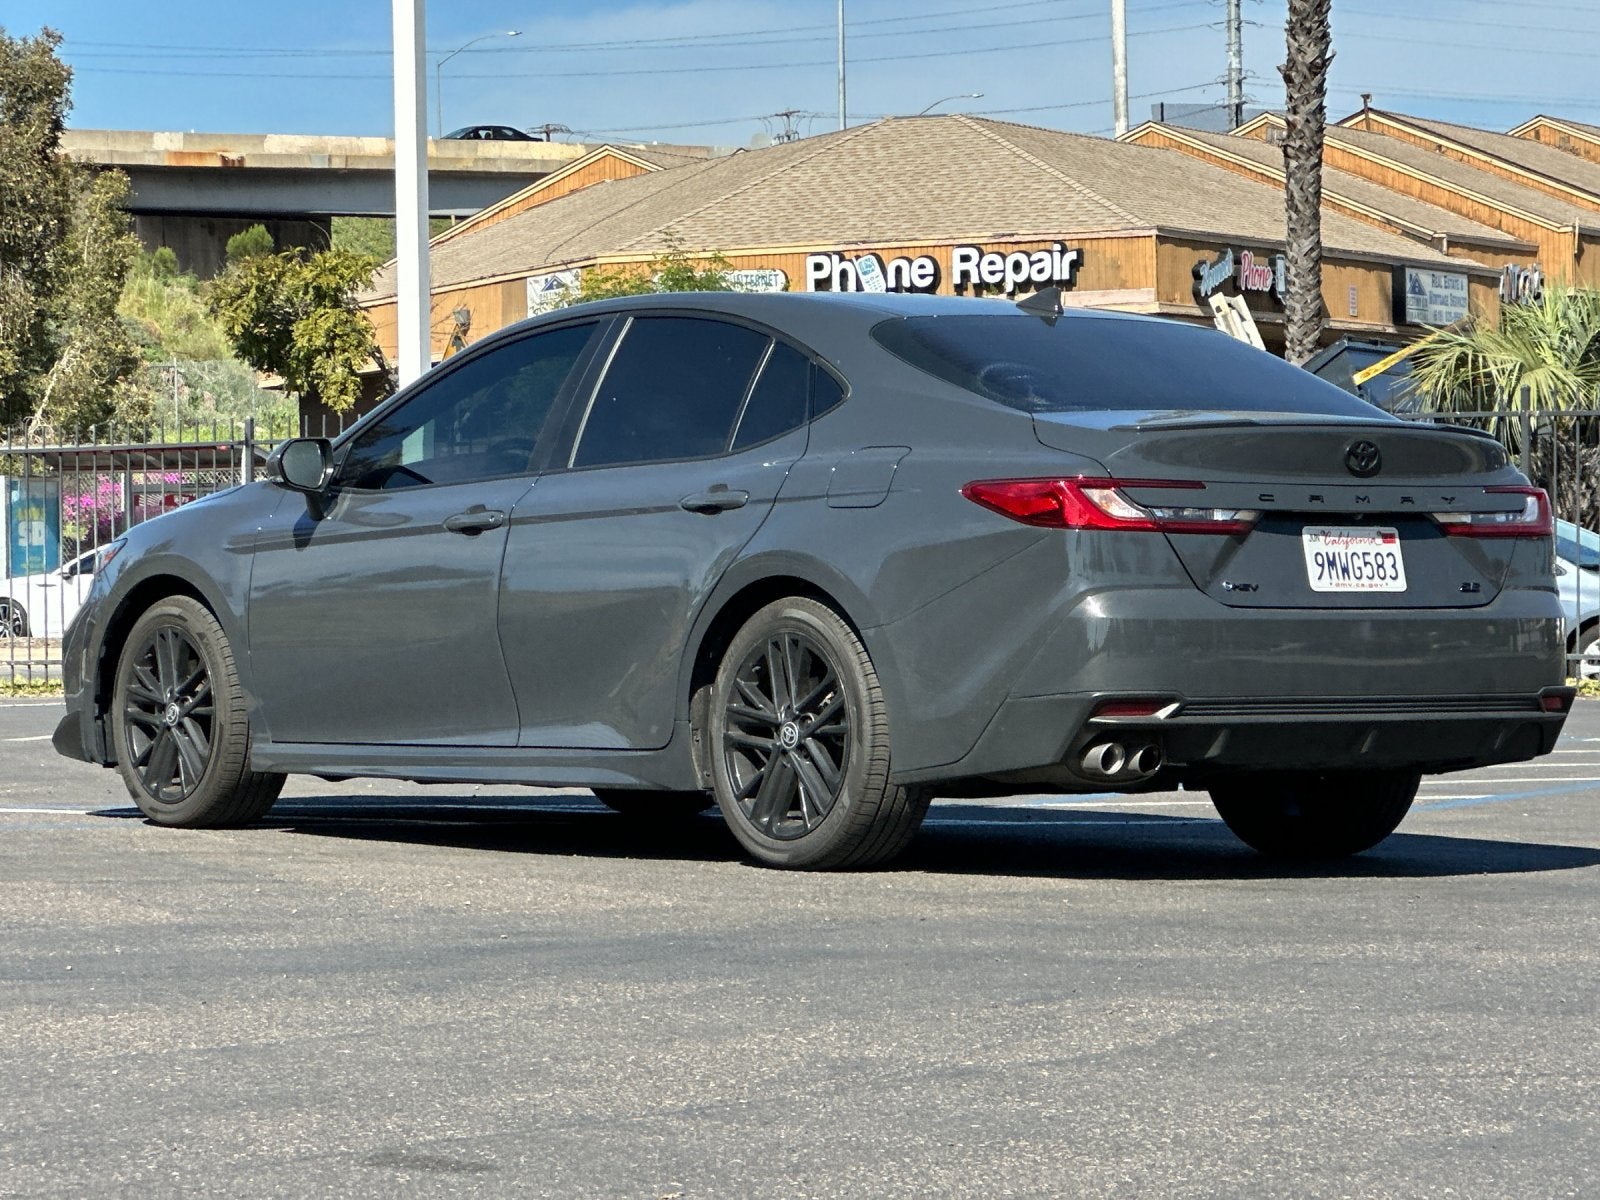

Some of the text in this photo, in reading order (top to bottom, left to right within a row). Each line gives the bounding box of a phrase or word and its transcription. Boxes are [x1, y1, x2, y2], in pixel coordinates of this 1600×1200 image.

[952, 244, 1078, 292] Repair
[1240, 249, 1274, 292] Phone
[1323, 530, 1377, 550] California
[1314, 552, 1399, 580] 9MWG583
